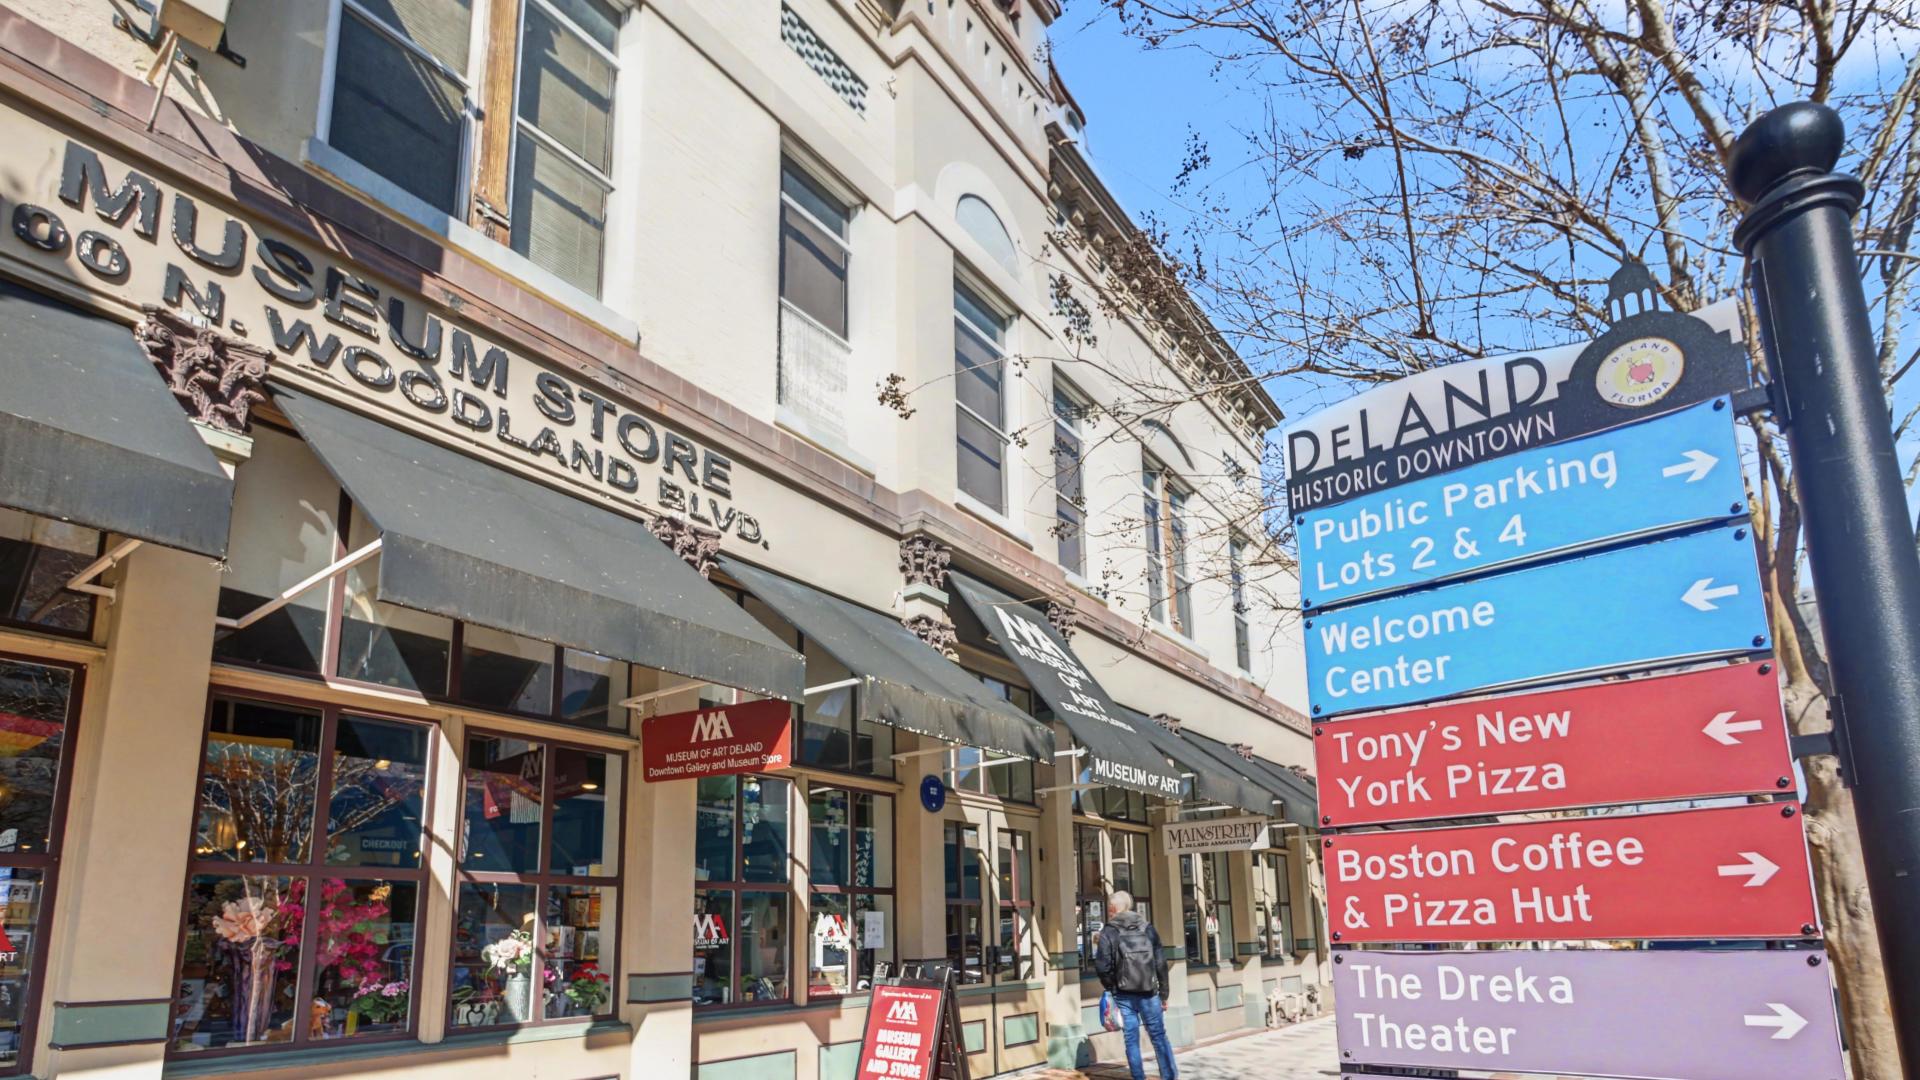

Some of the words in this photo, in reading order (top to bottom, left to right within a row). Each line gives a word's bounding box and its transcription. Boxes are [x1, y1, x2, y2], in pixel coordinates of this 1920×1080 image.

[59, 140, 508, 398] MUSEUM
[534, 371, 732, 499] STORE
[1611, 343, 1670, 363] DLAND
[163, 263, 247, 335] N.
[265, 304, 639, 493] WOODLAND
[658, 476, 769, 550] BLVD.
[1611, 380, 1670, 404] FLORIDA
[1291, 460, 1388, 510] HISTORIC
[1397, 411, 1556, 473] DOWNTOWN
[1314, 497, 1429, 550] Public
[1443, 449, 1618, 517] Parking
[1316, 550, 1397, 592] Lots
[1410, 536, 1437, 571] 2
[1453, 526, 1481, 560] &
[1498, 513, 1527, 547] 4
[1320, 599, 1496, 656] Welcome
[1010, 640, 1093, 684] MUSEUM
[1058, 672, 1082, 691] OF
[1325, 654, 1451, 699] Center
[1068, 689, 1106, 714] ART
[666, 749, 699, 763] MUSEUM
[700, 748, 711, 760] OF
[713, 745, 728, 757] ART
[729, 741, 763, 755] DELAND
[1333, 720, 1463, 767] Tony's
[1476, 709, 1572, 748] New
[649, 766, 685, 777] Downtown
[686, 761, 711, 773] Gallery
[712, 758, 725, 769] and
[728, 755, 759, 768] Museum
[761, 753, 782, 764] Store
[1095, 758, 1147, 786] MUSEUM
[1148, 773, 1160, 787] OF
[1160, 777, 1181, 795] ART
[1337, 769, 1432, 809] York
[1447, 761, 1567, 799] Pizza
[362, 839, 408, 849] CHECKOUT
[1168, 821, 1262, 849] MAINSTREET
[1337, 843, 1476, 883] Boston
[1491, 831, 1645, 874] Coffee
[1342, 895, 1370, 930] &
[1384, 892, 1497, 929] Pizza
[1512, 883, 1593, 926] Hut
[1350, 964, 1422, 1000] The
[1438, 964, 1575, 1005] Dreka
[875, 1043, 918, 1063] GALLERY
[876, 1028, 921, 1047] MUSEUM
[1353, 1012, 1517, 1055] Theater
[865, 1058, 888, 1075] AND
[889, 1061, 922, 1079] STORE
